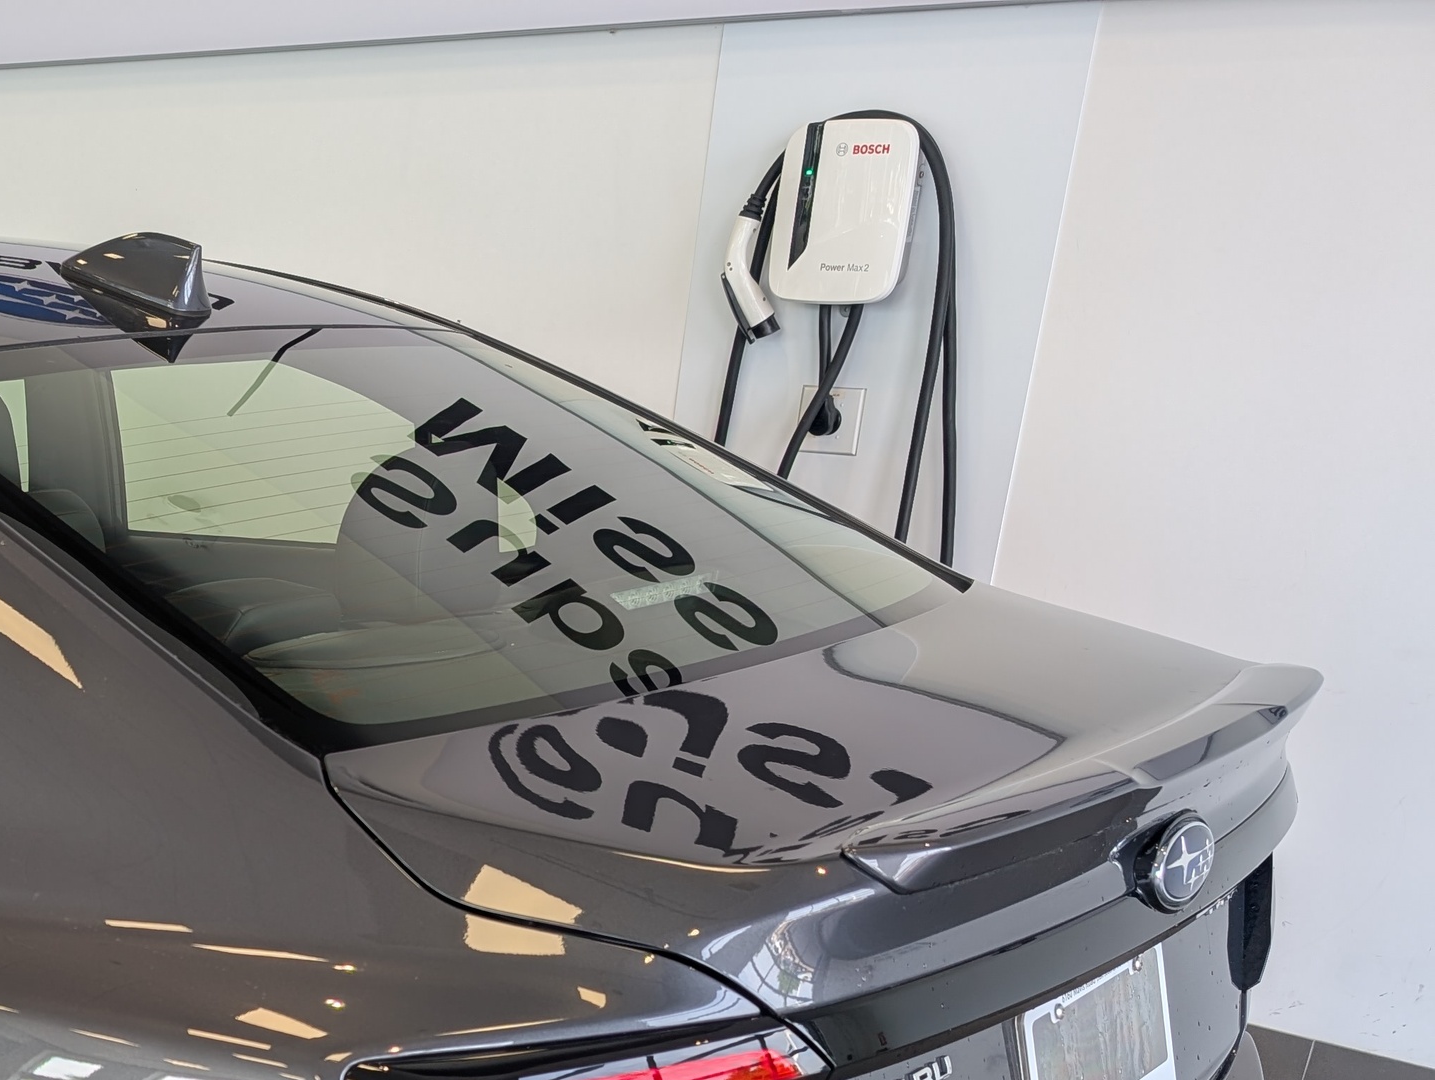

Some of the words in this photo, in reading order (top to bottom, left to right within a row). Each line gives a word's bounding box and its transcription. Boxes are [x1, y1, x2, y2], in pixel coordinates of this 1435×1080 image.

[852, 143, 891, 155] BOSCH
[819, 262, 845, 272] Power
[847, 263, 863, 272] Max
